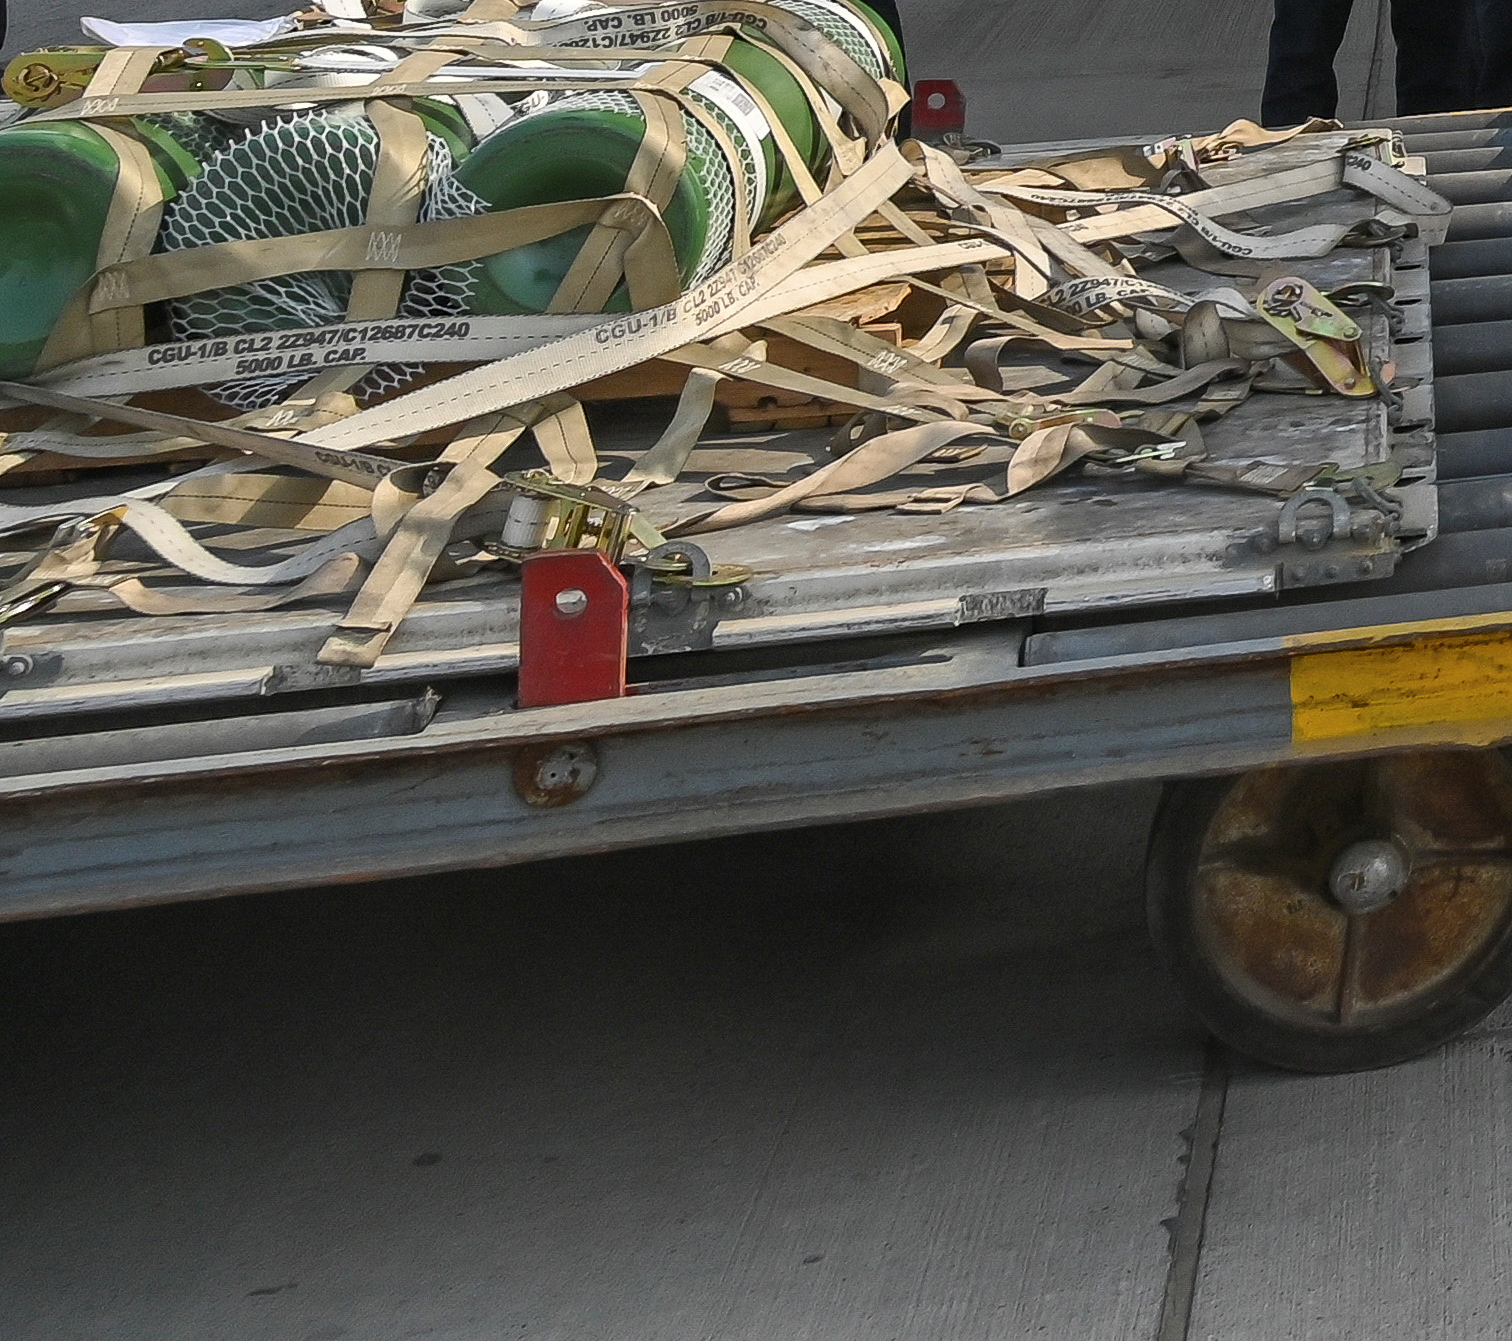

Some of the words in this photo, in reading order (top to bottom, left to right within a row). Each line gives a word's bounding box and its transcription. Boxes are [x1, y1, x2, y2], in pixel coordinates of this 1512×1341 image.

[626, 11, 656, 26] LB.
[660, 4, 699, 22] 5000
[705, 11, 768, 30] CGU-1/B
[583, 16, 623, 32] CAP.
[675, 17, 702, 35] CL2
[695, 300, 721, 326] 5000
[721, 290, 739, 310] LB.
[738, 271, 761, 297] CAP.
[595, 307, 677, 344] CGU-1/B
[683, 290, 706, 314] CL2
[148, 340, 228, 365] CGU-1/B
[233, 335, 272, 356] CL2
[275, 321, 470, 351] 2Z947/C12687C240
[235, 354, 282, 375] 5000
[286, 351, 318, 368] LB.
[323, 347, 367, 363] CAP.
